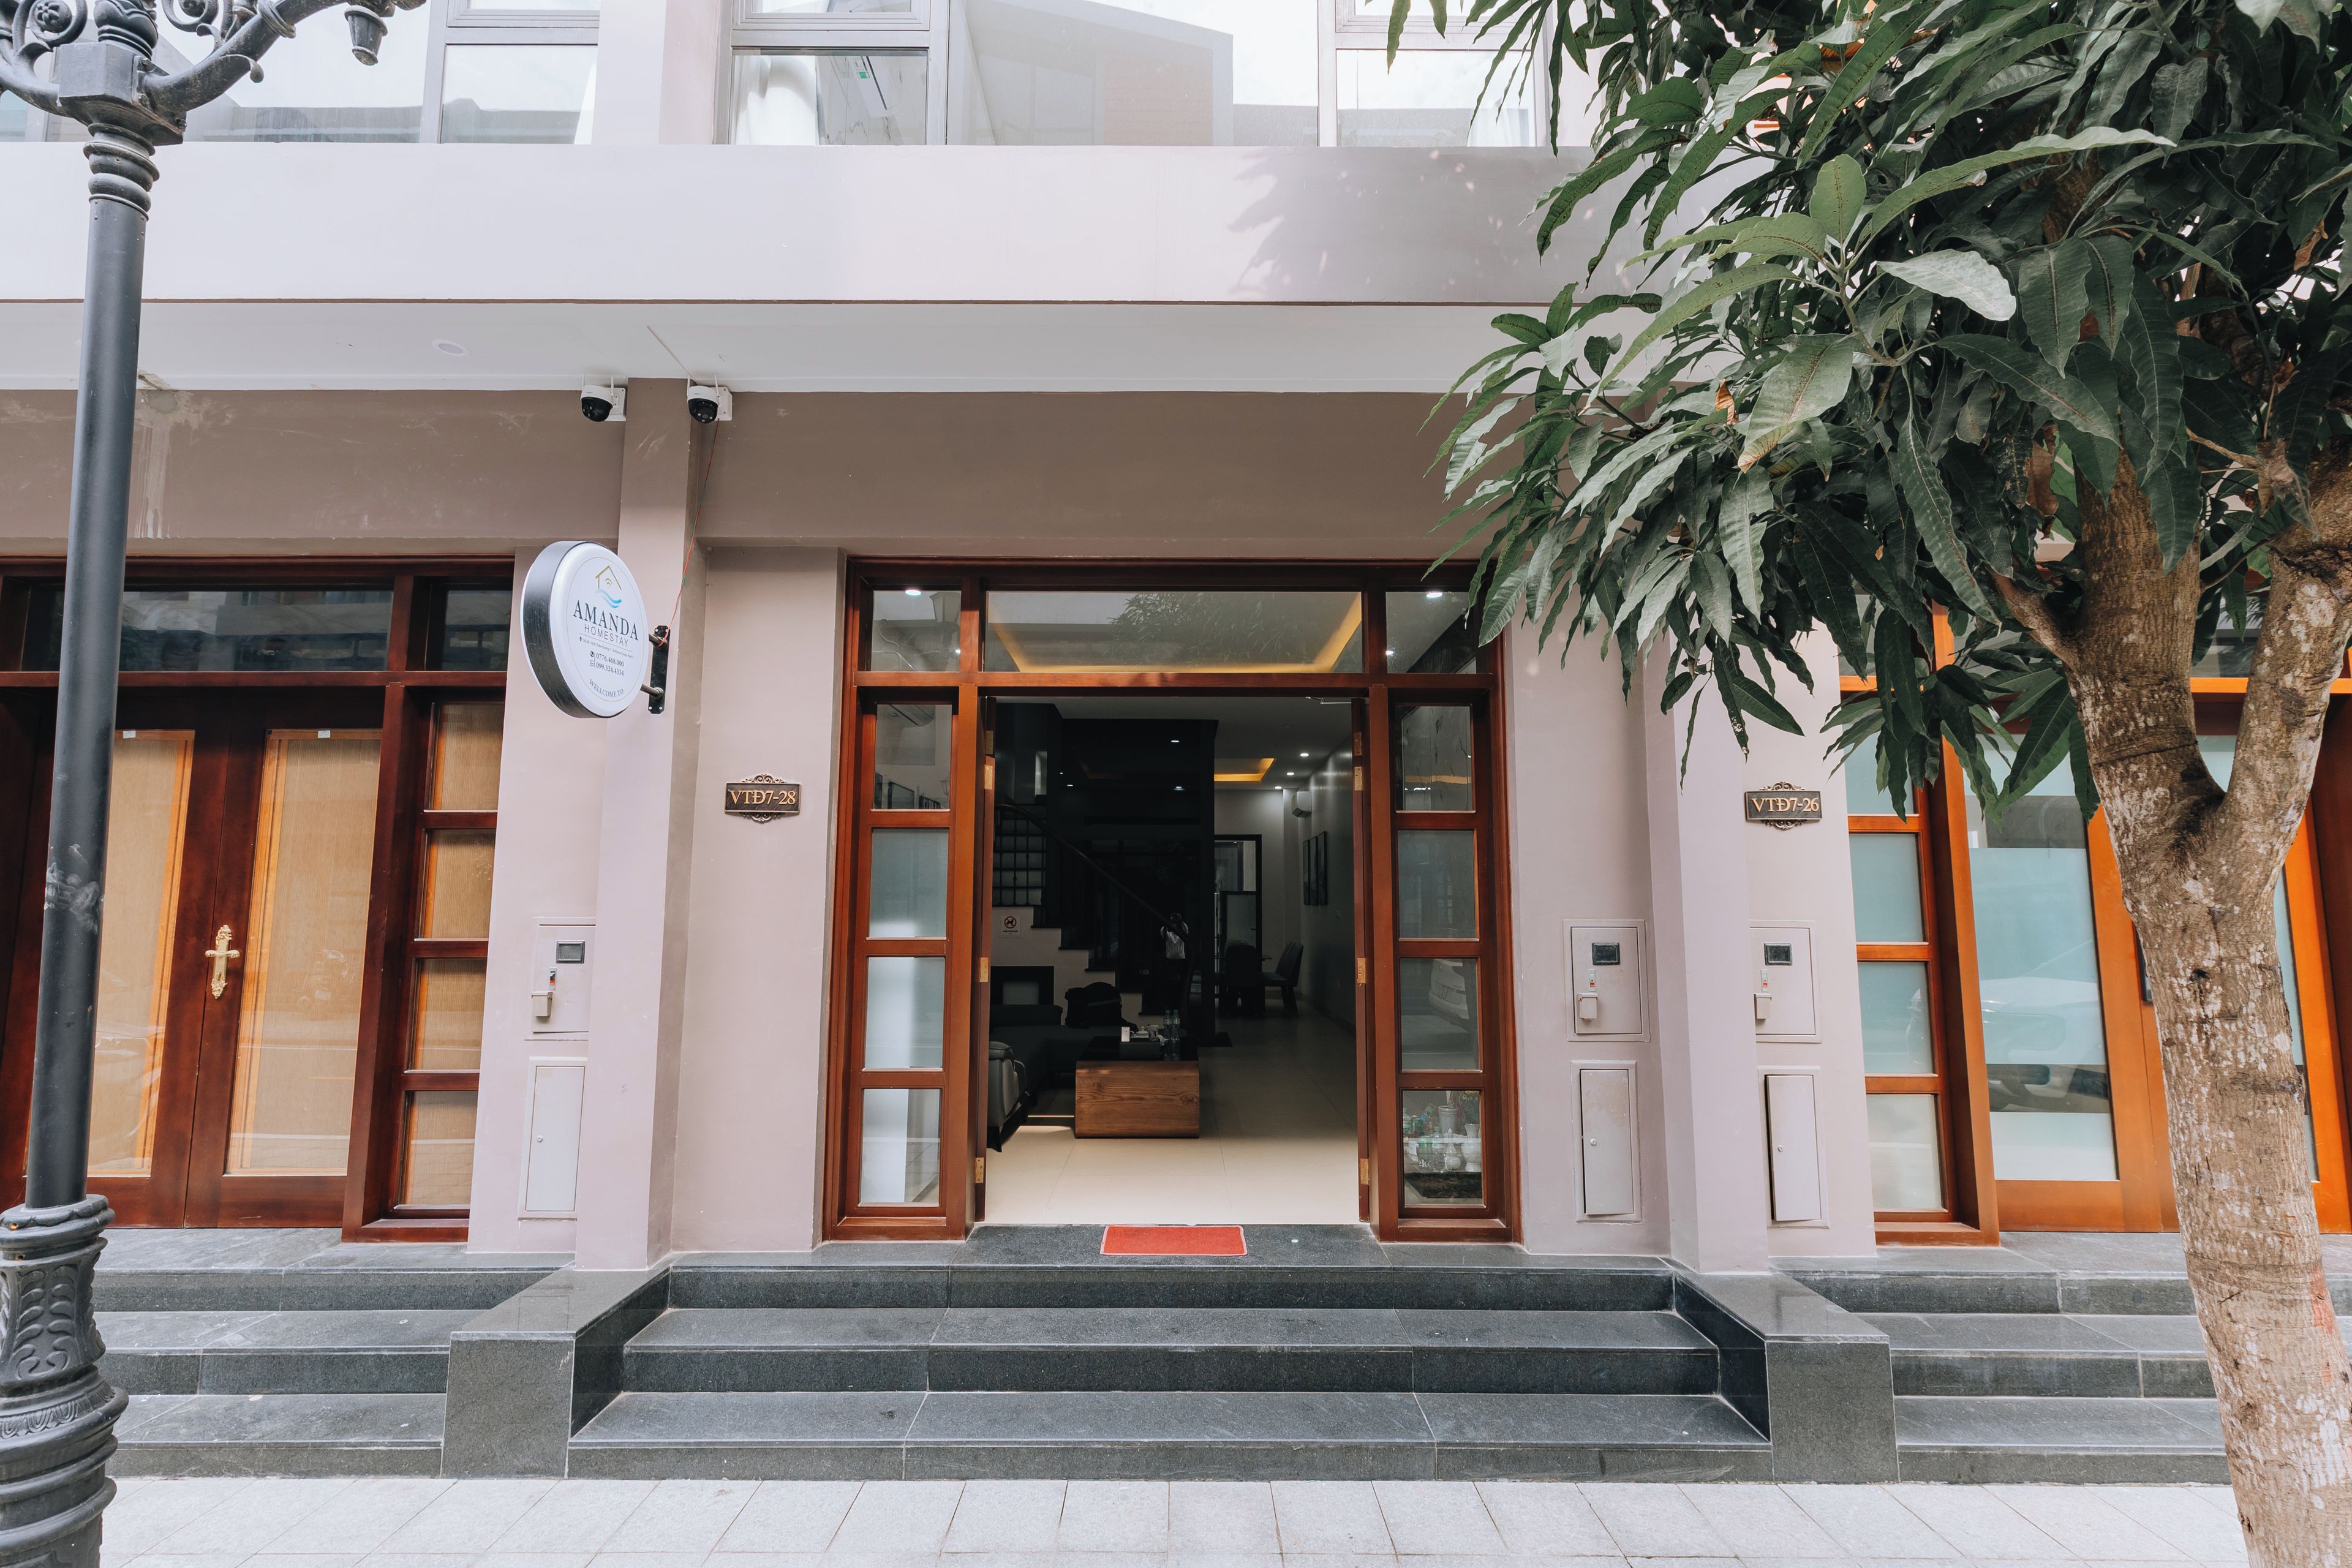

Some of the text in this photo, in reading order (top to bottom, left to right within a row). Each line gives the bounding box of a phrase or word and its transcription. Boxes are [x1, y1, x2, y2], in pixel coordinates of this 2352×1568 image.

[573, 600, 639, 641] AMANDA
[584, 624, 629, 647] HOMESTAY
[596, 652, 625, 667] 0776.468.000
[589, 679, 617, 698] WELLCOME
[729, 790, 796, 805] VTĐ7-28
[1751, 797, 1820, 812] VTĐ7-26
